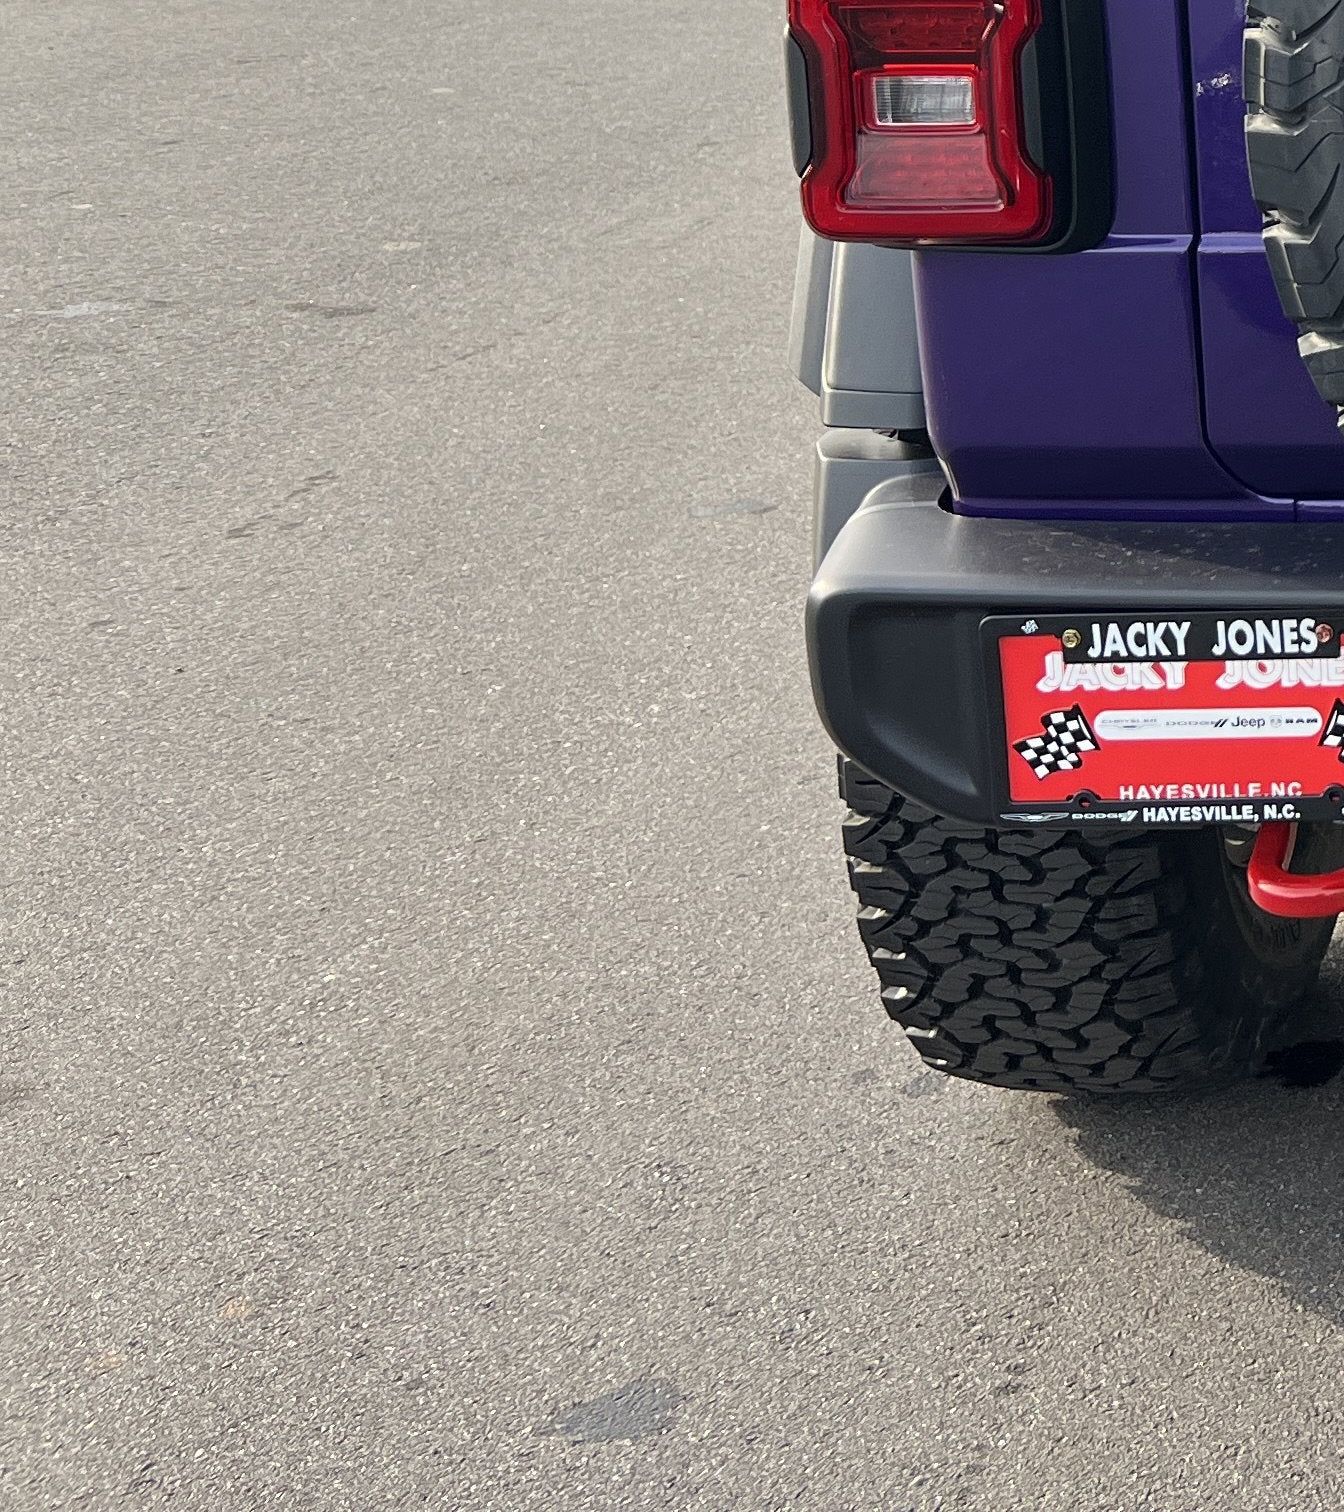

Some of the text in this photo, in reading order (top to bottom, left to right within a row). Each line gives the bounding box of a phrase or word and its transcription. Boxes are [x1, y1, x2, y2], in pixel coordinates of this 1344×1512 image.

[1087, 617, 1316, 658] JACKY JONES
[1036, 650, 1190, 692] JACKY
[1230, 716, 1266, 729] Jeep
[1142, 803, 1302, 823] HAYESVILLE, N.C.
